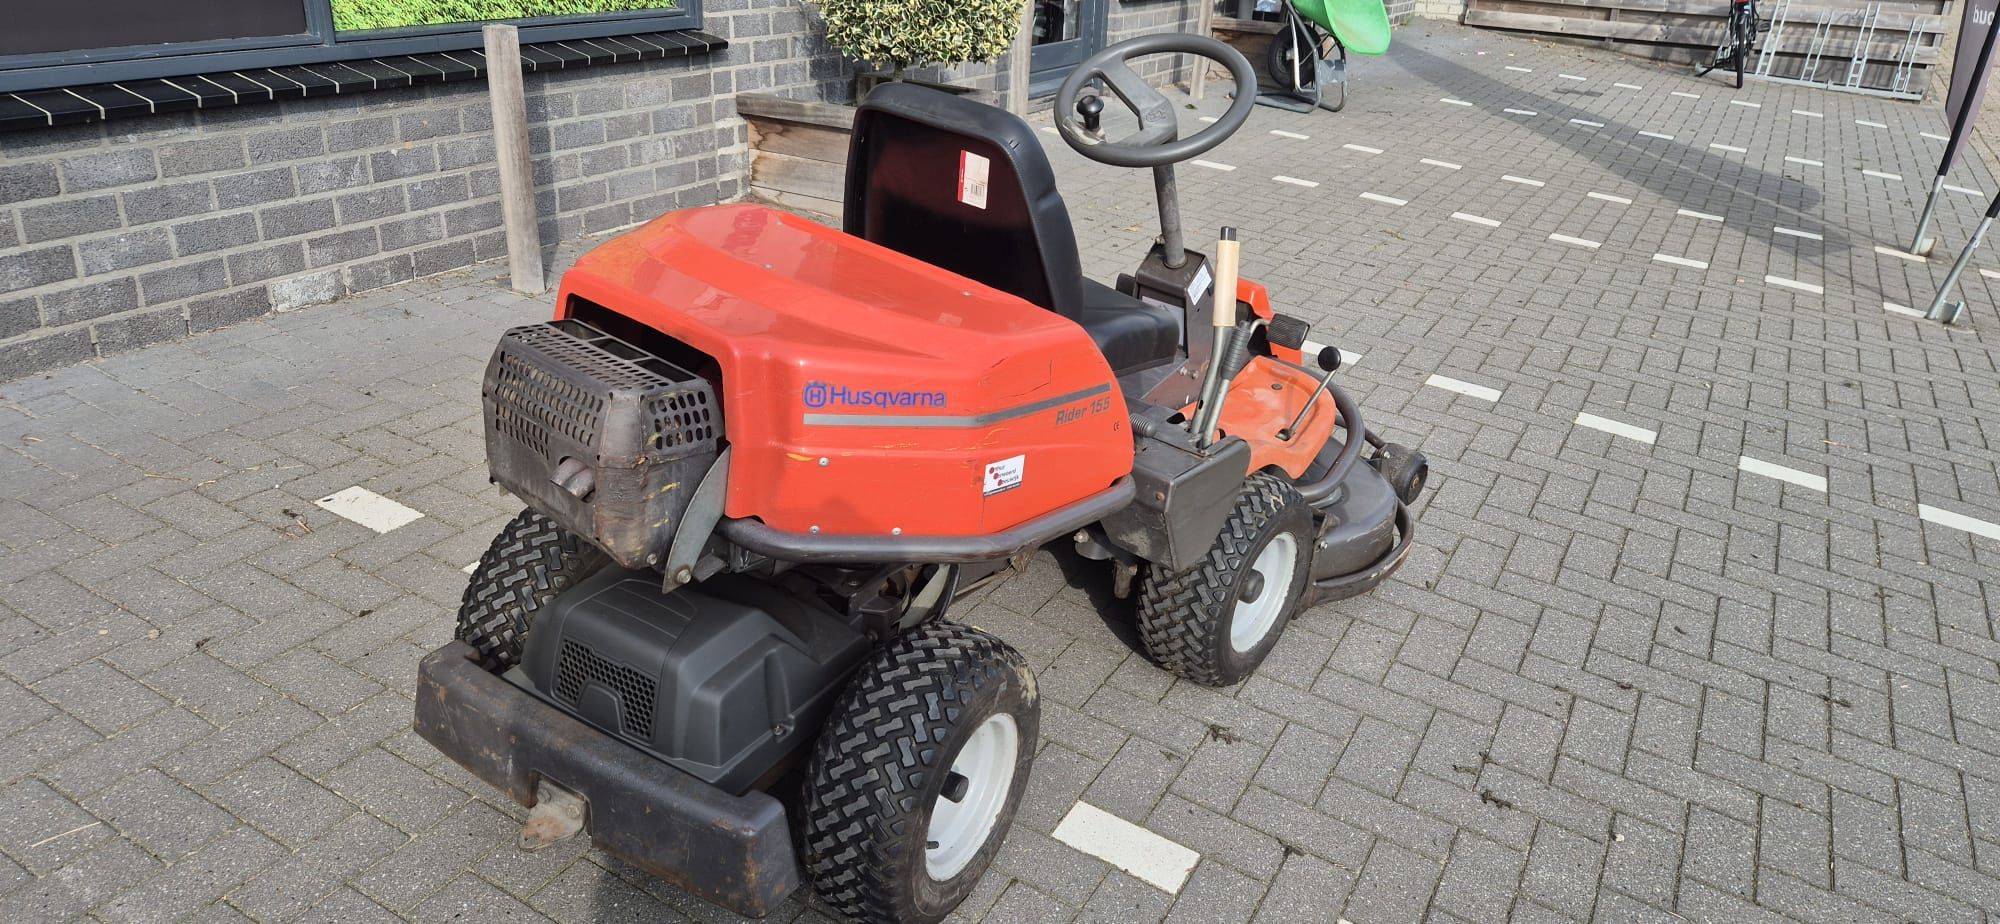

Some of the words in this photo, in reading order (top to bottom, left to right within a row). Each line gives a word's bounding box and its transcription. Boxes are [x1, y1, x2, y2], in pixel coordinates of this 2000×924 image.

[829, 386, 946, 408] Husqvarna
[1056, 407, 1088, 425] Rider
[1090, 396, 1110, 415] 155
